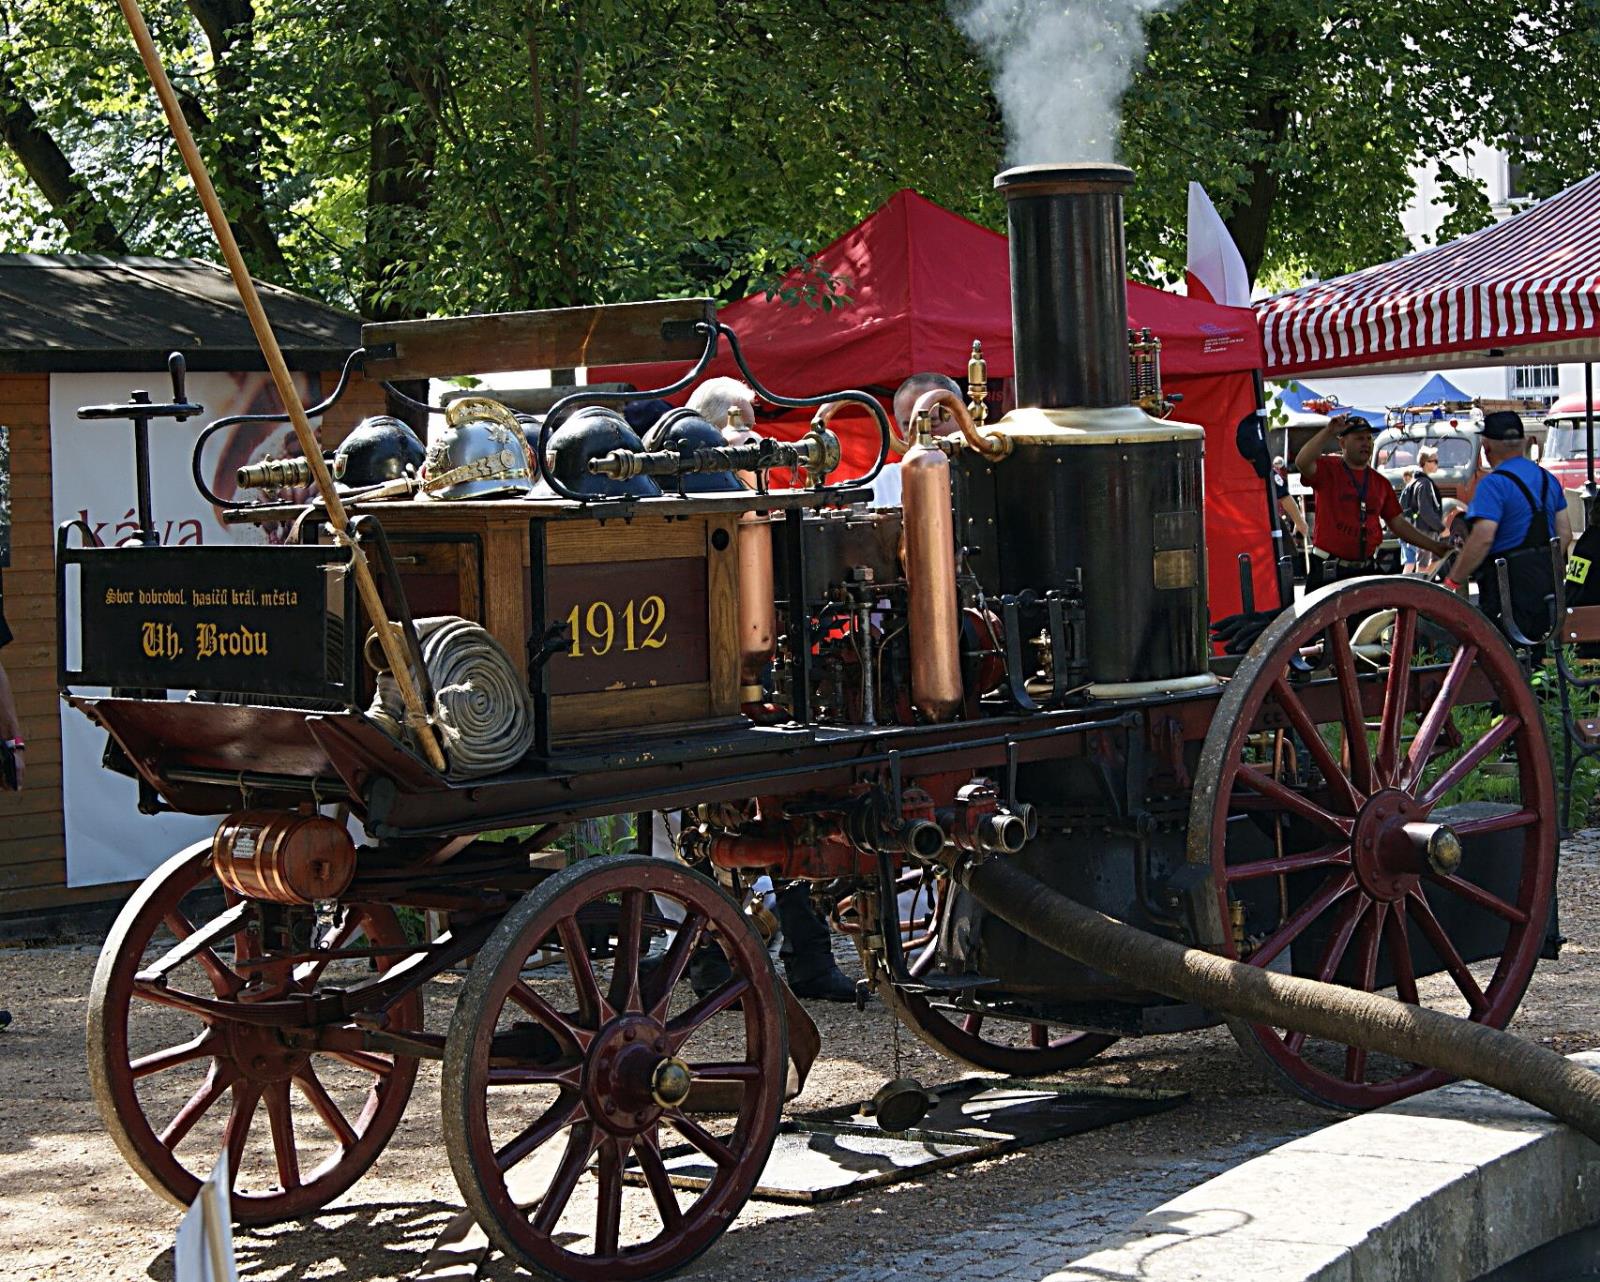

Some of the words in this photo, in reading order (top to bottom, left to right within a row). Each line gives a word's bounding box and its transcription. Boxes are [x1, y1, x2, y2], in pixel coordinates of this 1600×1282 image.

[105, 587, 134, 605] Sbor
[192, 588, 228, 607] hasičů
[261, 588, 298, 606] města
[141, 621, 184, 660] Uh.
[195, 621, 269, 660] Brodu
[566, 595, 667, 657] 1912
